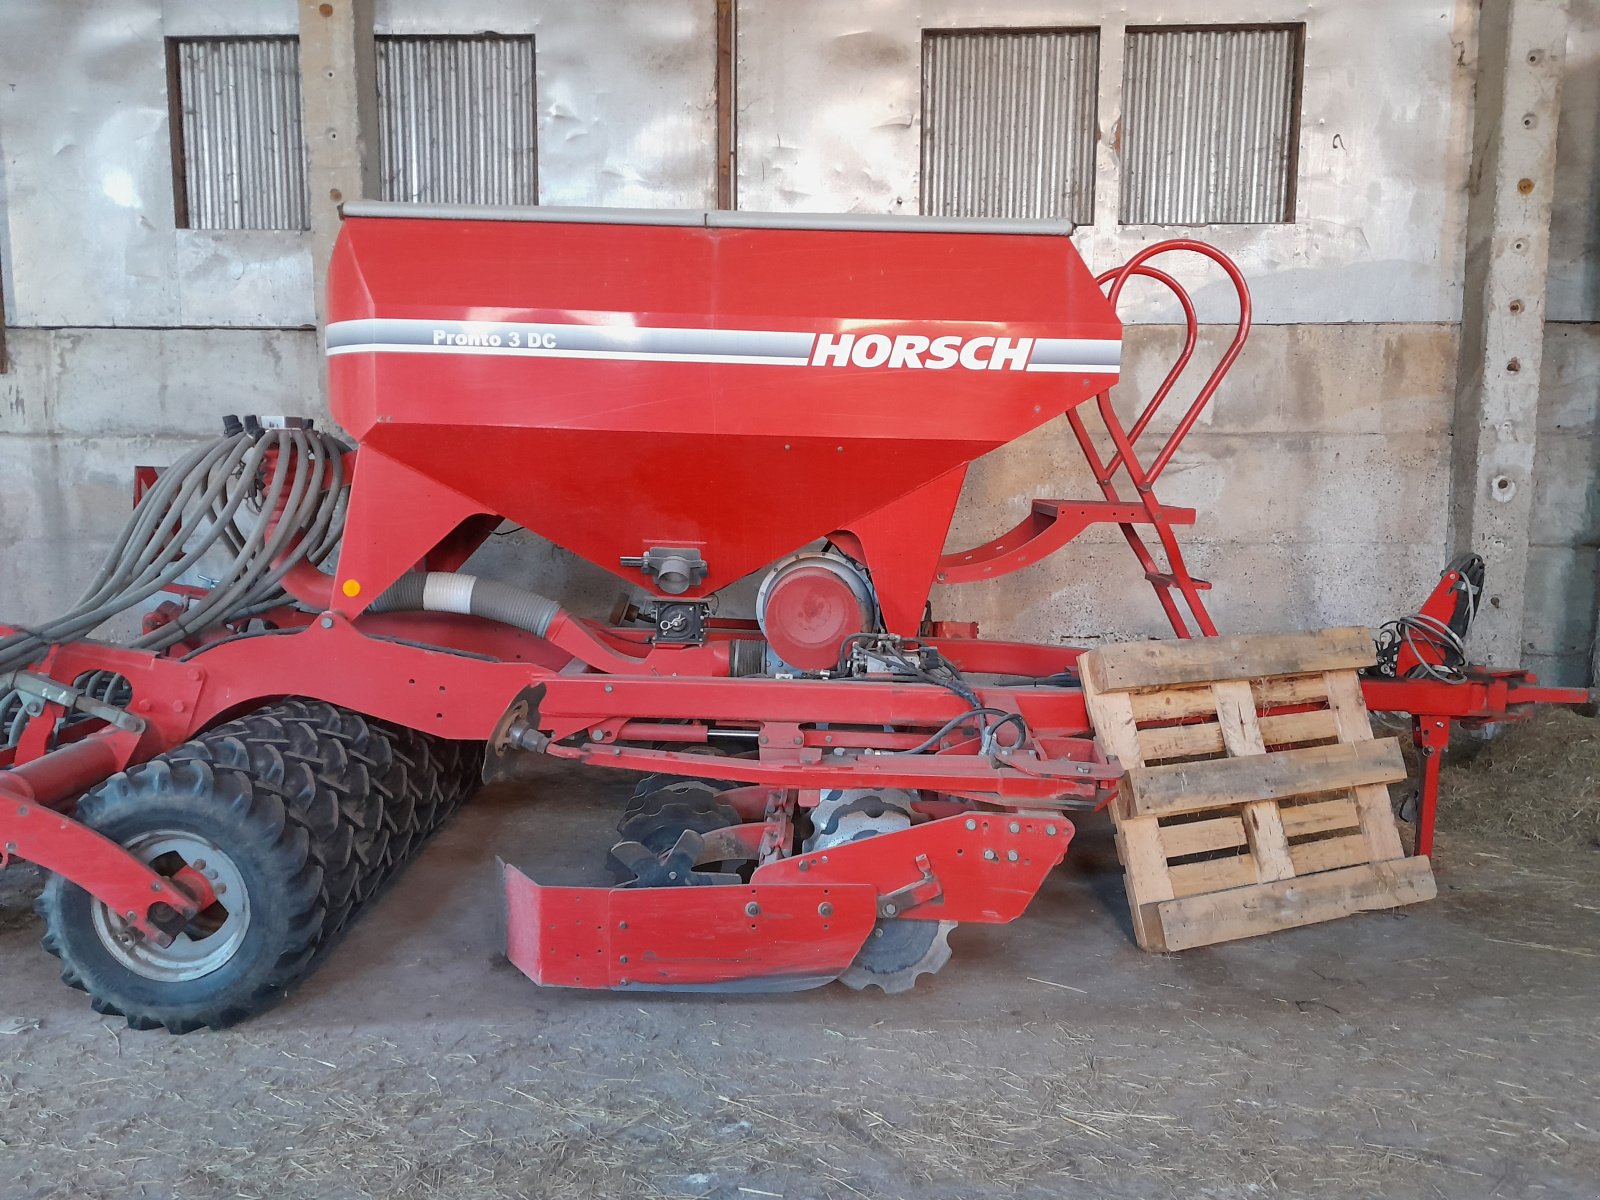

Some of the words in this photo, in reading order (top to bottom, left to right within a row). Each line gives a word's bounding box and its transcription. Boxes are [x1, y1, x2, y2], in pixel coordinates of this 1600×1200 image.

[432, 329, 502, 347] Pronto
[508, 331, 521, 348] 3
[527, 332, 557, 349] DC
[811, 333, 1033, 371] HORSCH
